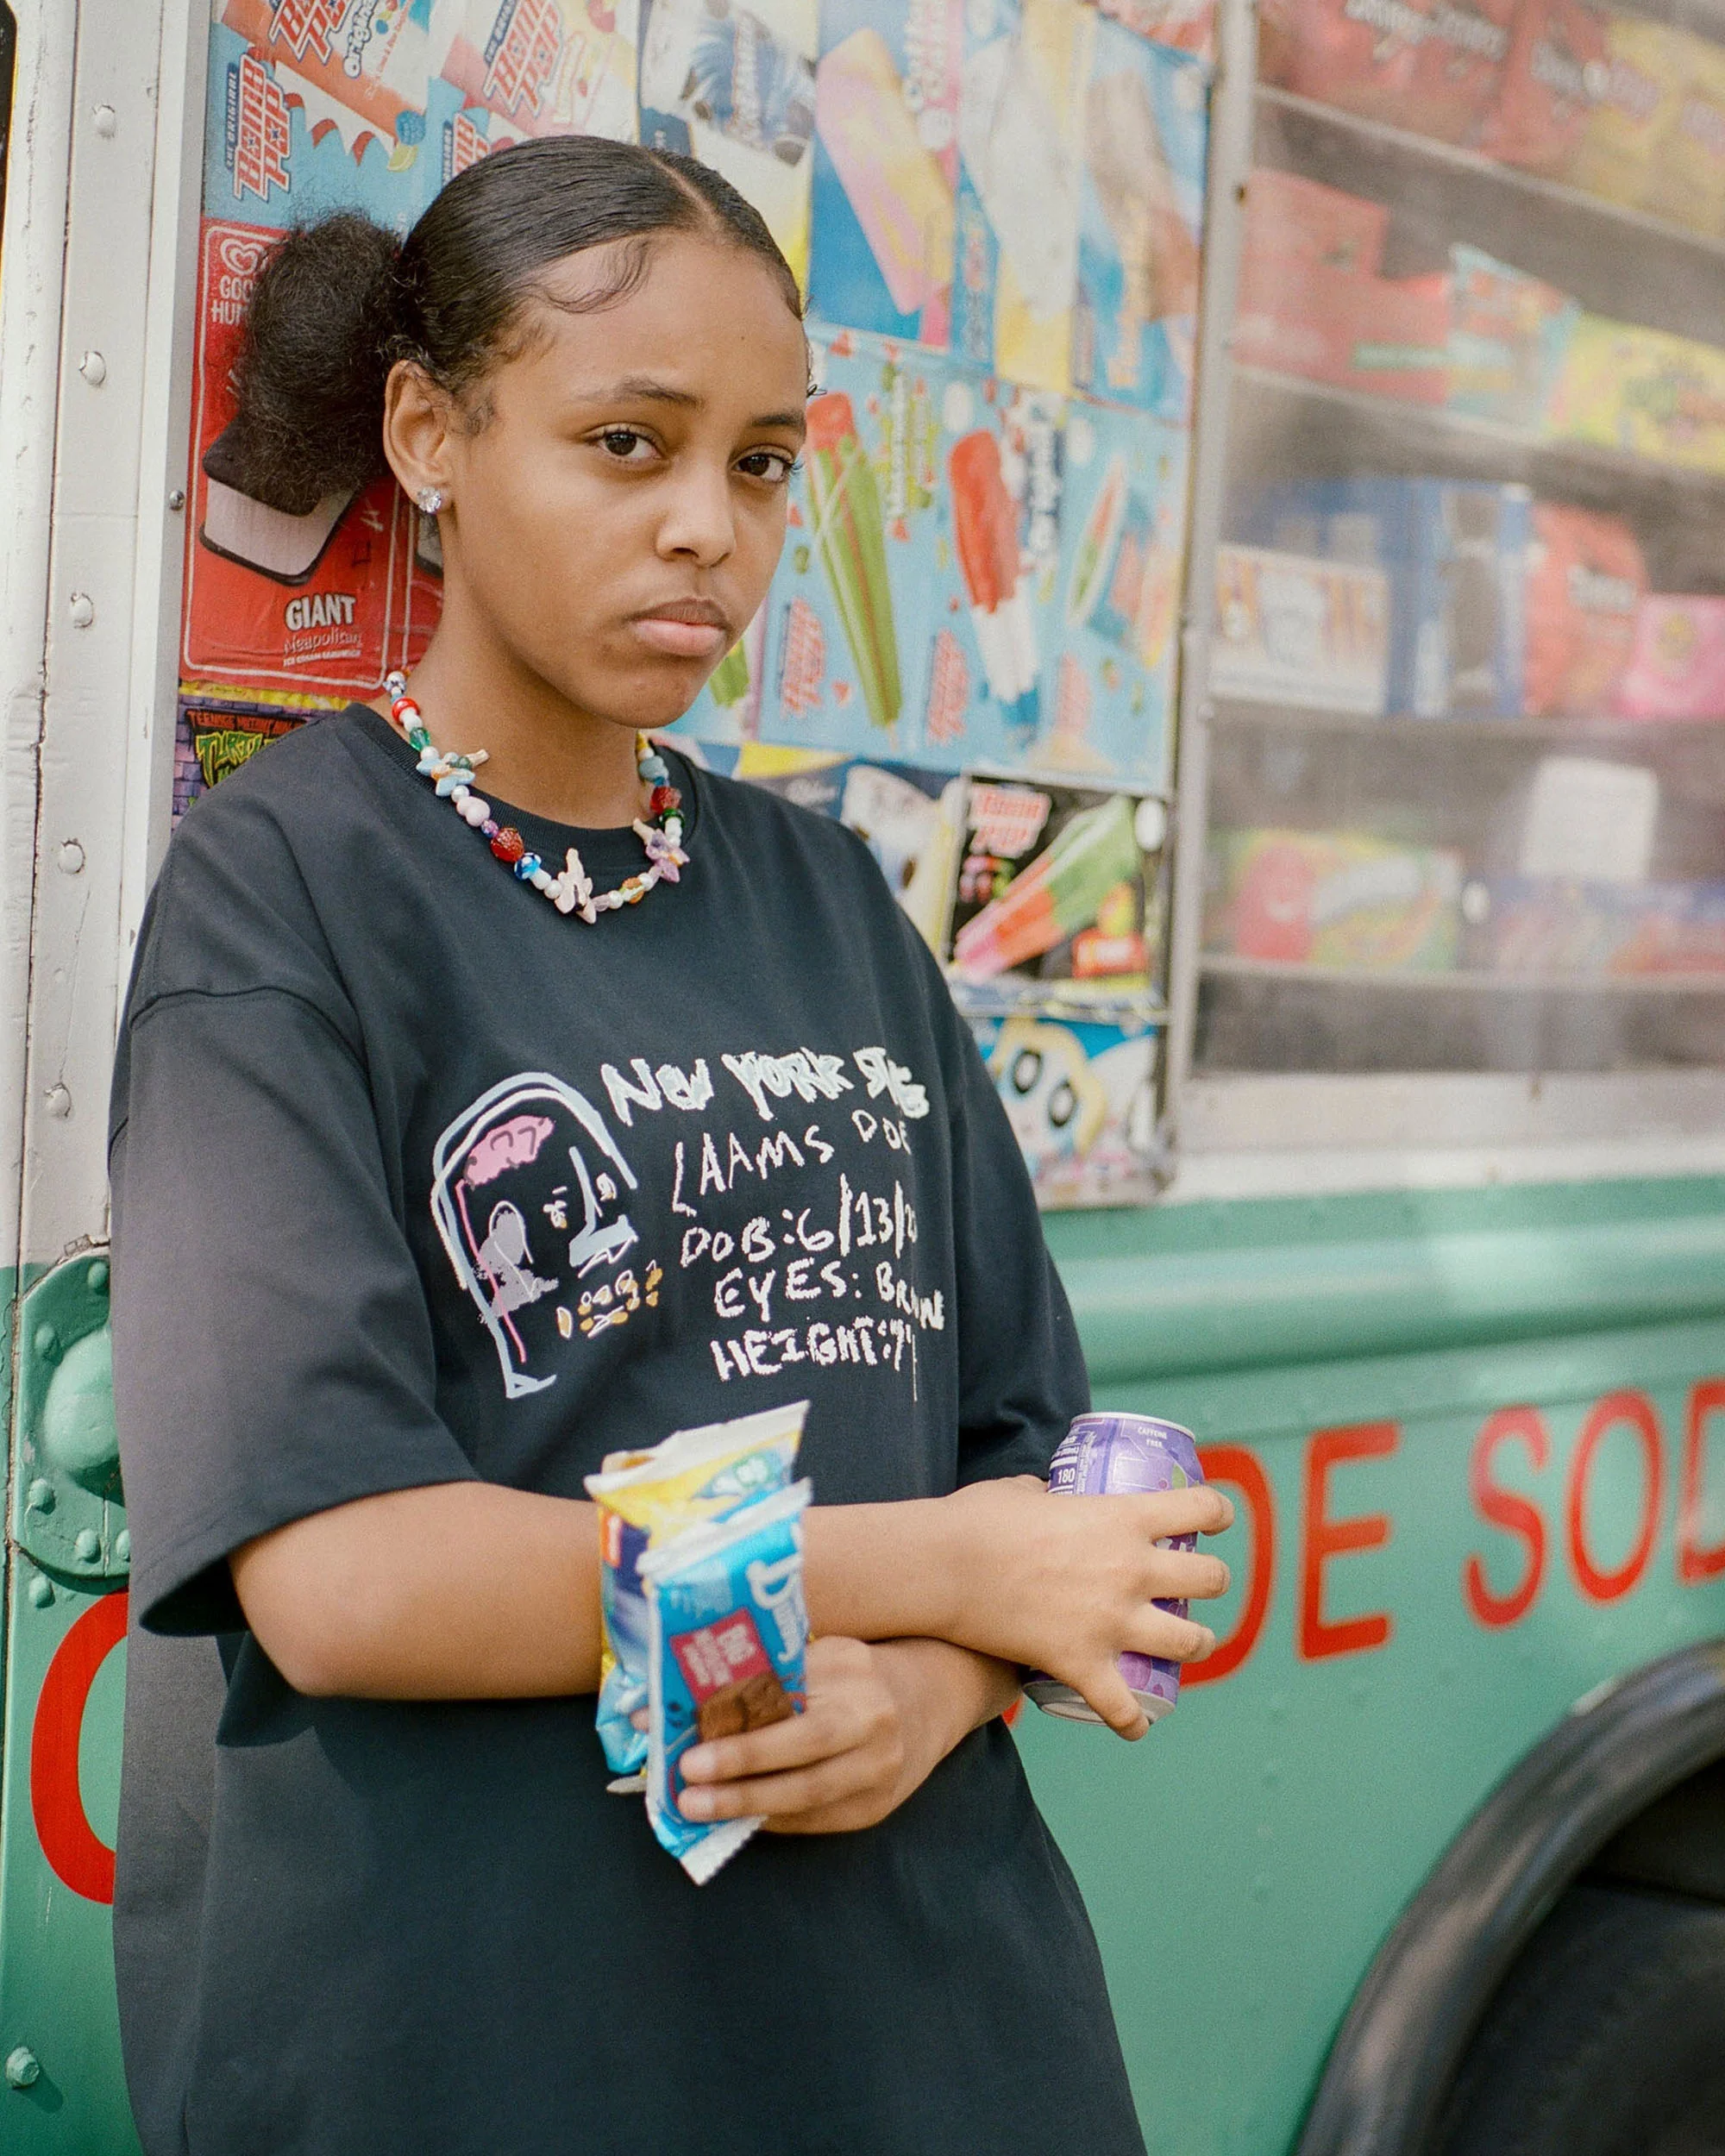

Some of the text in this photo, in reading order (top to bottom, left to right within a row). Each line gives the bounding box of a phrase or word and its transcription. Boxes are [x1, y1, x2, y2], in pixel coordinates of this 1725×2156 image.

[261, 79, 291, 202] POP
[285, 592, 356, 631] GIANT
[284, 627, 361, 655] Neapolitan
[721, 1046, 855, 1121] YORK
[671, 1125, 835, 1217] LAAMS
[714, 1257, 862, 1323] EYES:
[1138, 1426, 1168, 1439] CAFFEINE
[1145, 1438, 1163, 1449] FREE
[1057, 1468, 1076, 1484] 180
